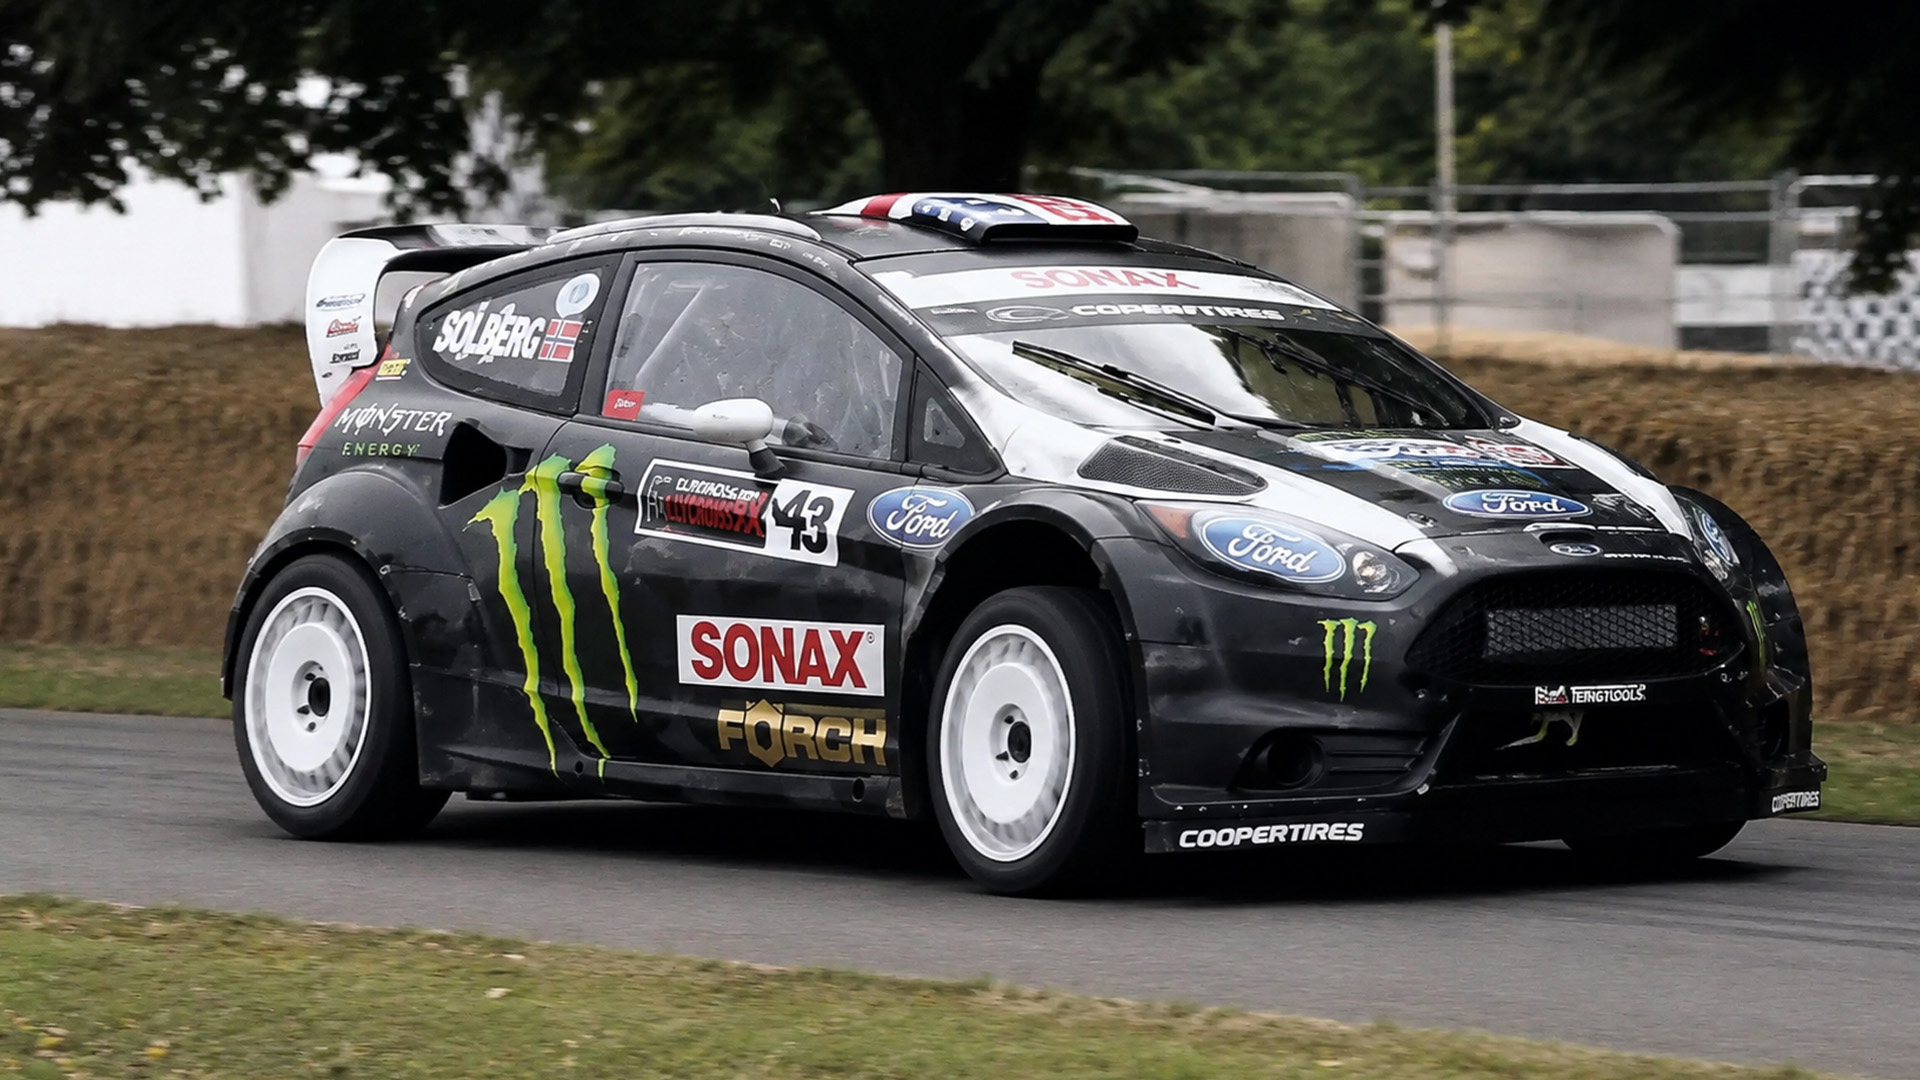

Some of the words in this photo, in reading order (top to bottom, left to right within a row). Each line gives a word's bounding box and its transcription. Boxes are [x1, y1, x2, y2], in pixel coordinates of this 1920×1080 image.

[1010, 269, 1200, 290] SONAX
[432, 301, 547, 363] SOLBERG
[771, 489, 834, 554] 43
[885, 493, 959, 539] Ford
[1480, 491, 1567, 513] Ford
[1227, 522, 1319, 573] Ford
[690, 620, 868, 689] SONAX
[1178, 822, 1365, 848] COOPERTIRES
